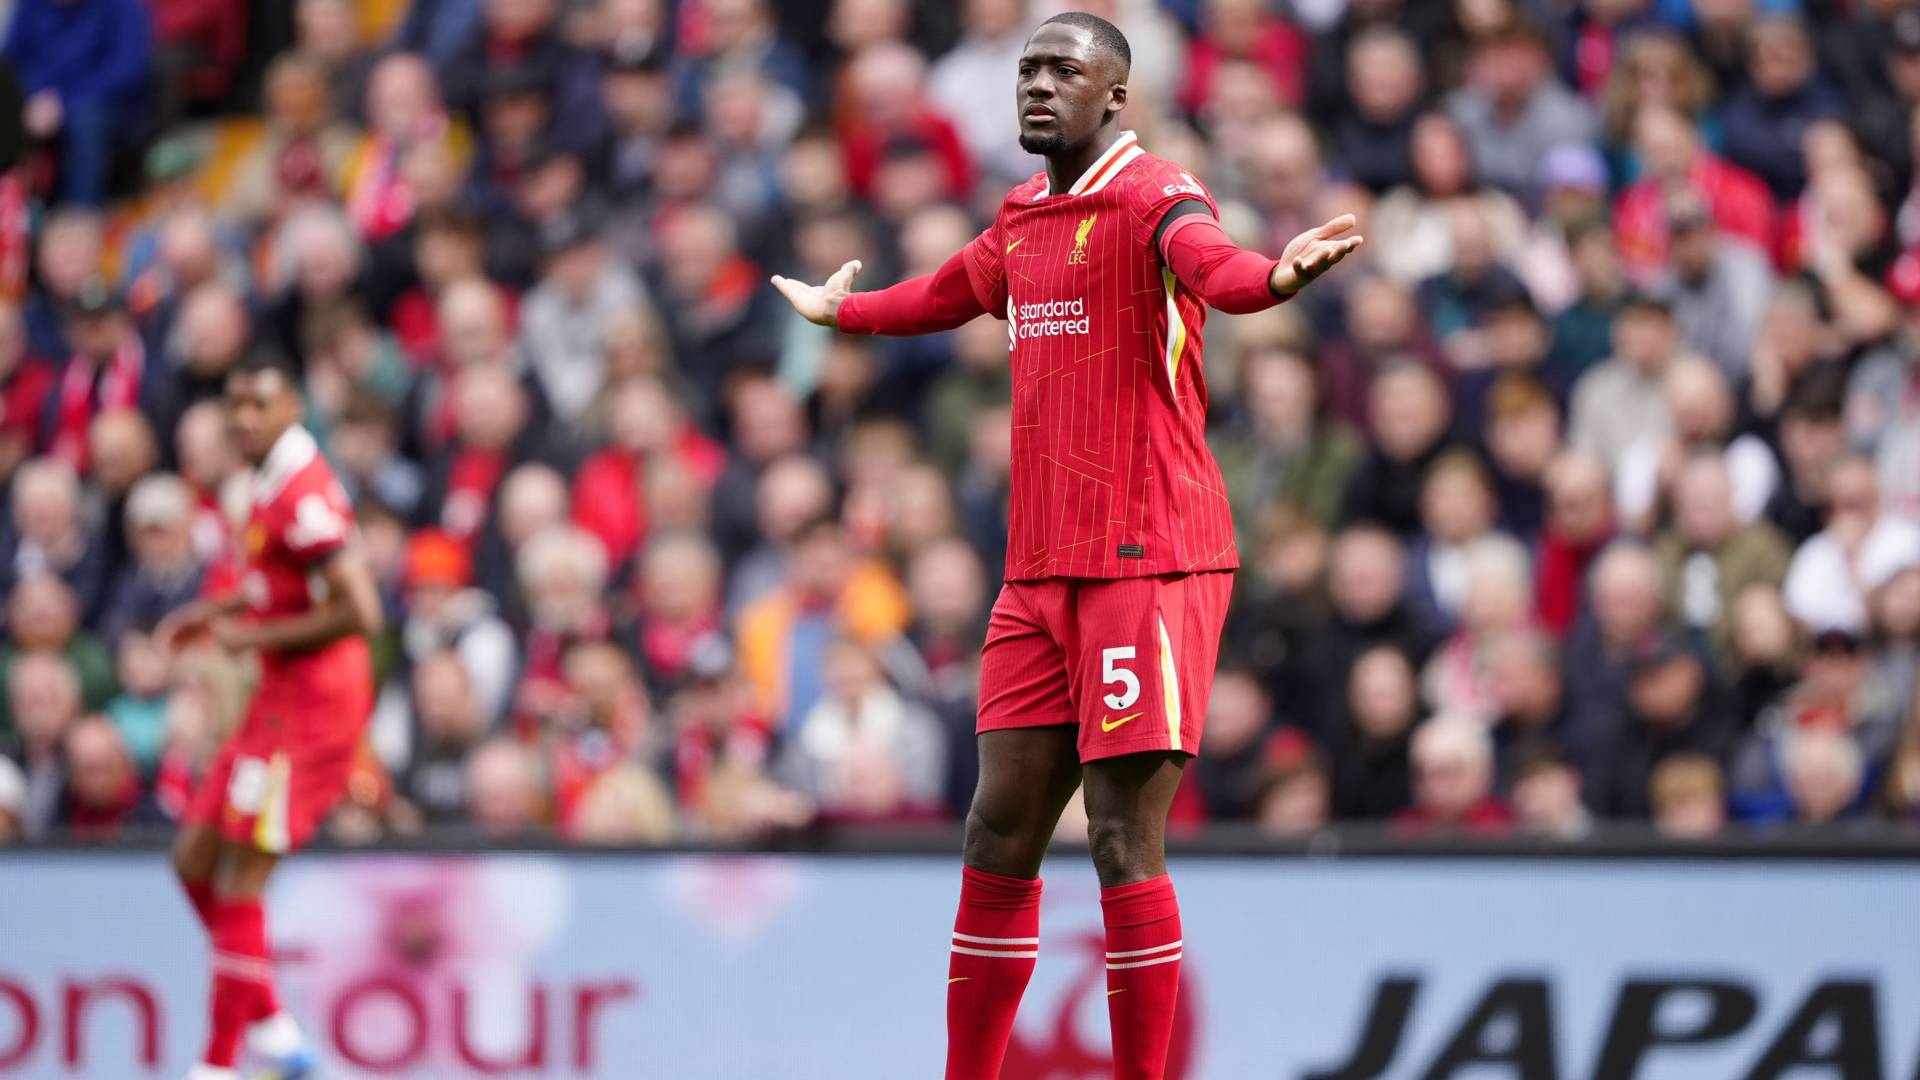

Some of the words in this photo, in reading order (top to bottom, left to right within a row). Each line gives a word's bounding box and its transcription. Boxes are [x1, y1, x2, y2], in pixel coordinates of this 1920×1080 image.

[1019, 316, 1089, 339] chartered
[1020, 297, 1083, 320] standard
[1103, 646, 1140, 710] 5
[268, 946, 638, 1074] our
[1294, 975, 1920, 1080] JAPA
